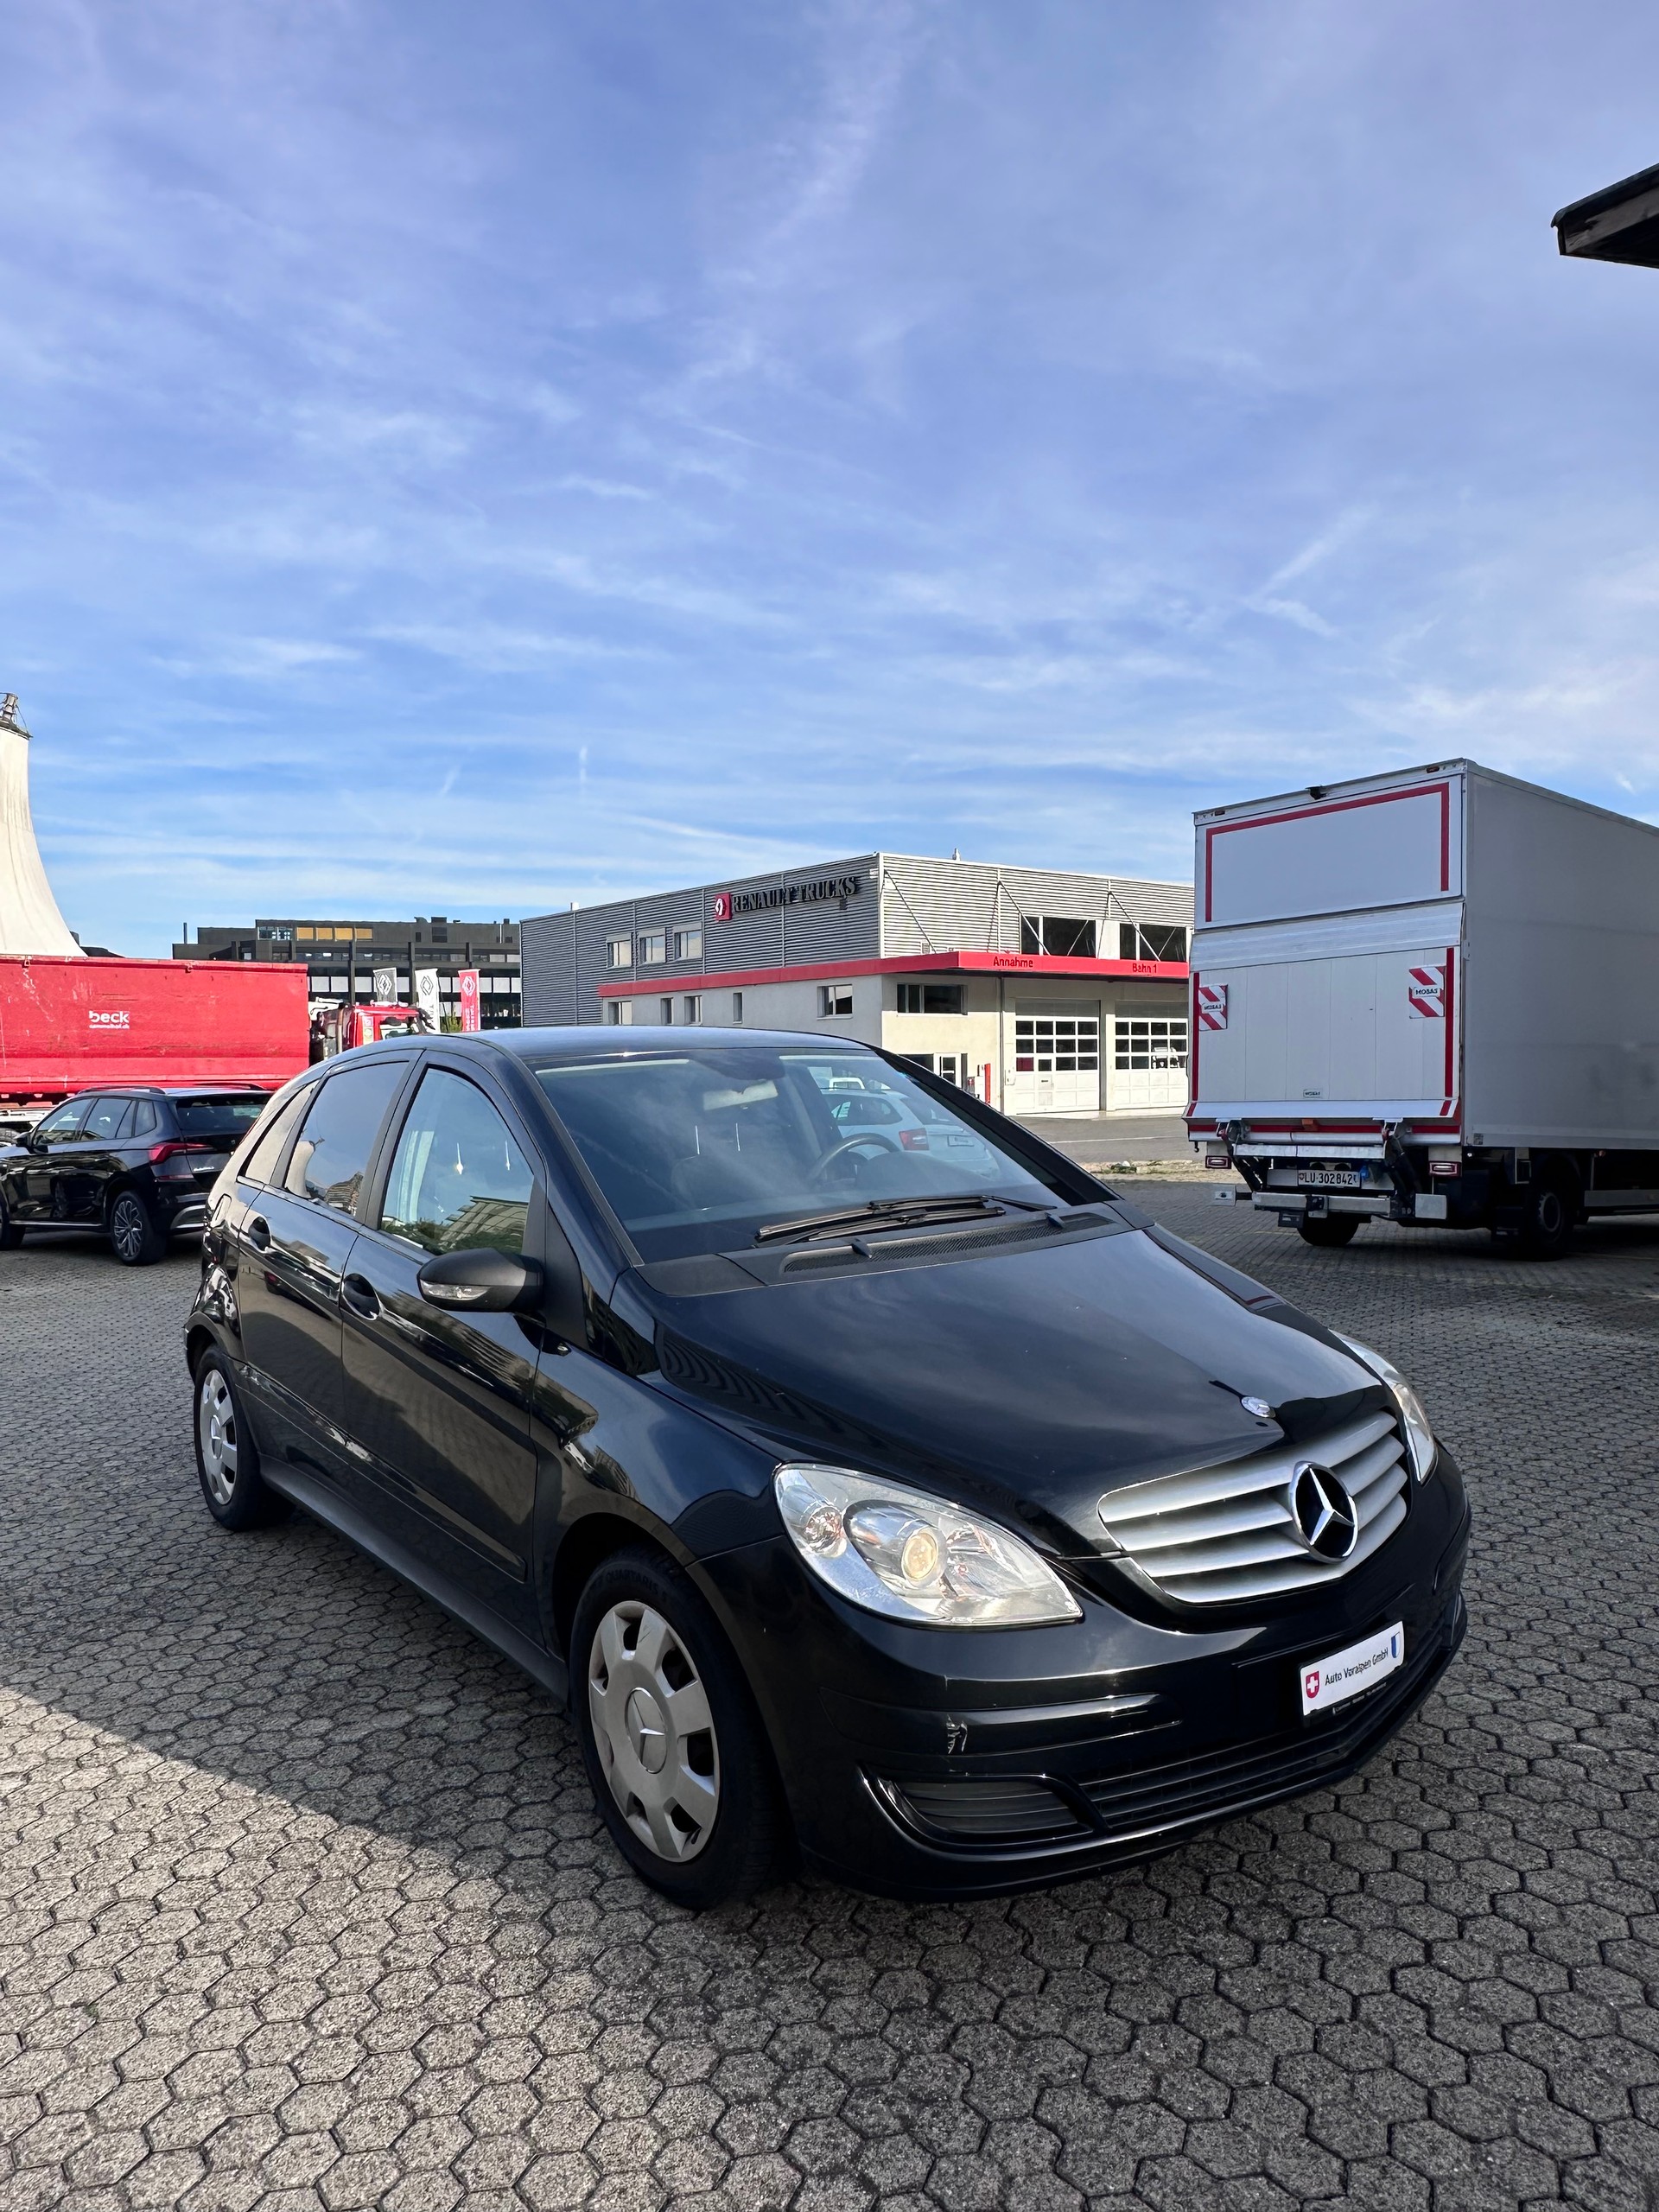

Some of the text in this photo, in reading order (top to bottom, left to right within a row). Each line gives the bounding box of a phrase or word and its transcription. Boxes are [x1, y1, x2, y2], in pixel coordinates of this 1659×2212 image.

[732, 876, 855, 912] RENAULT TRUCKS
[993, 956, 1033, 968] Annahme
[1132, 963, 1152, 973] Bahn
[88, 1010, 130, 1023] beck
[1325, 1671, 1343, 1686] Auto
[1372, 1647, 1389, 1666] GmbH
